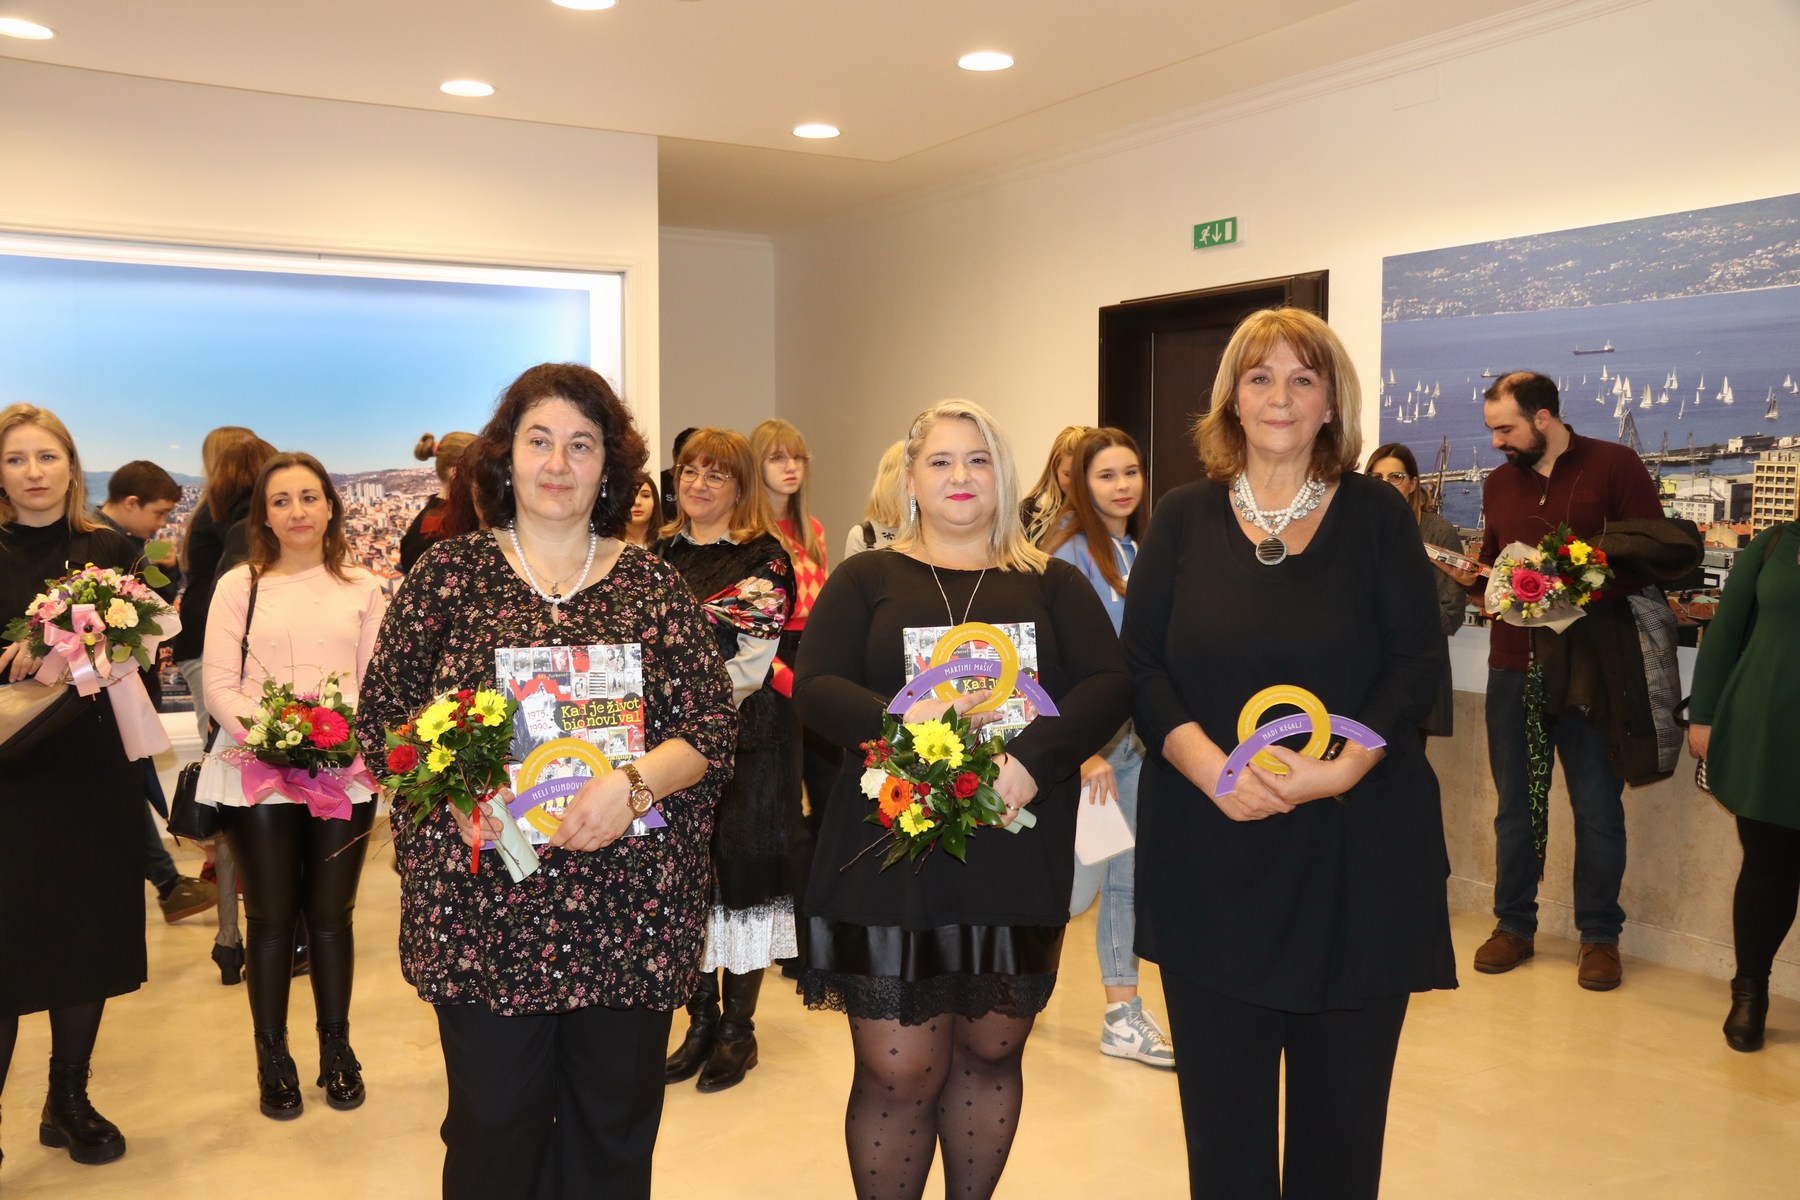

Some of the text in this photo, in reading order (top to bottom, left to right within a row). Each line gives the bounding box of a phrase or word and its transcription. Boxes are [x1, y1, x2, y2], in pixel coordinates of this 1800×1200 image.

[962, 677, 987, 691] Kad
[560, 697, 641, 719] Kad je život
[562, 710, 642, 731] bio novi val
